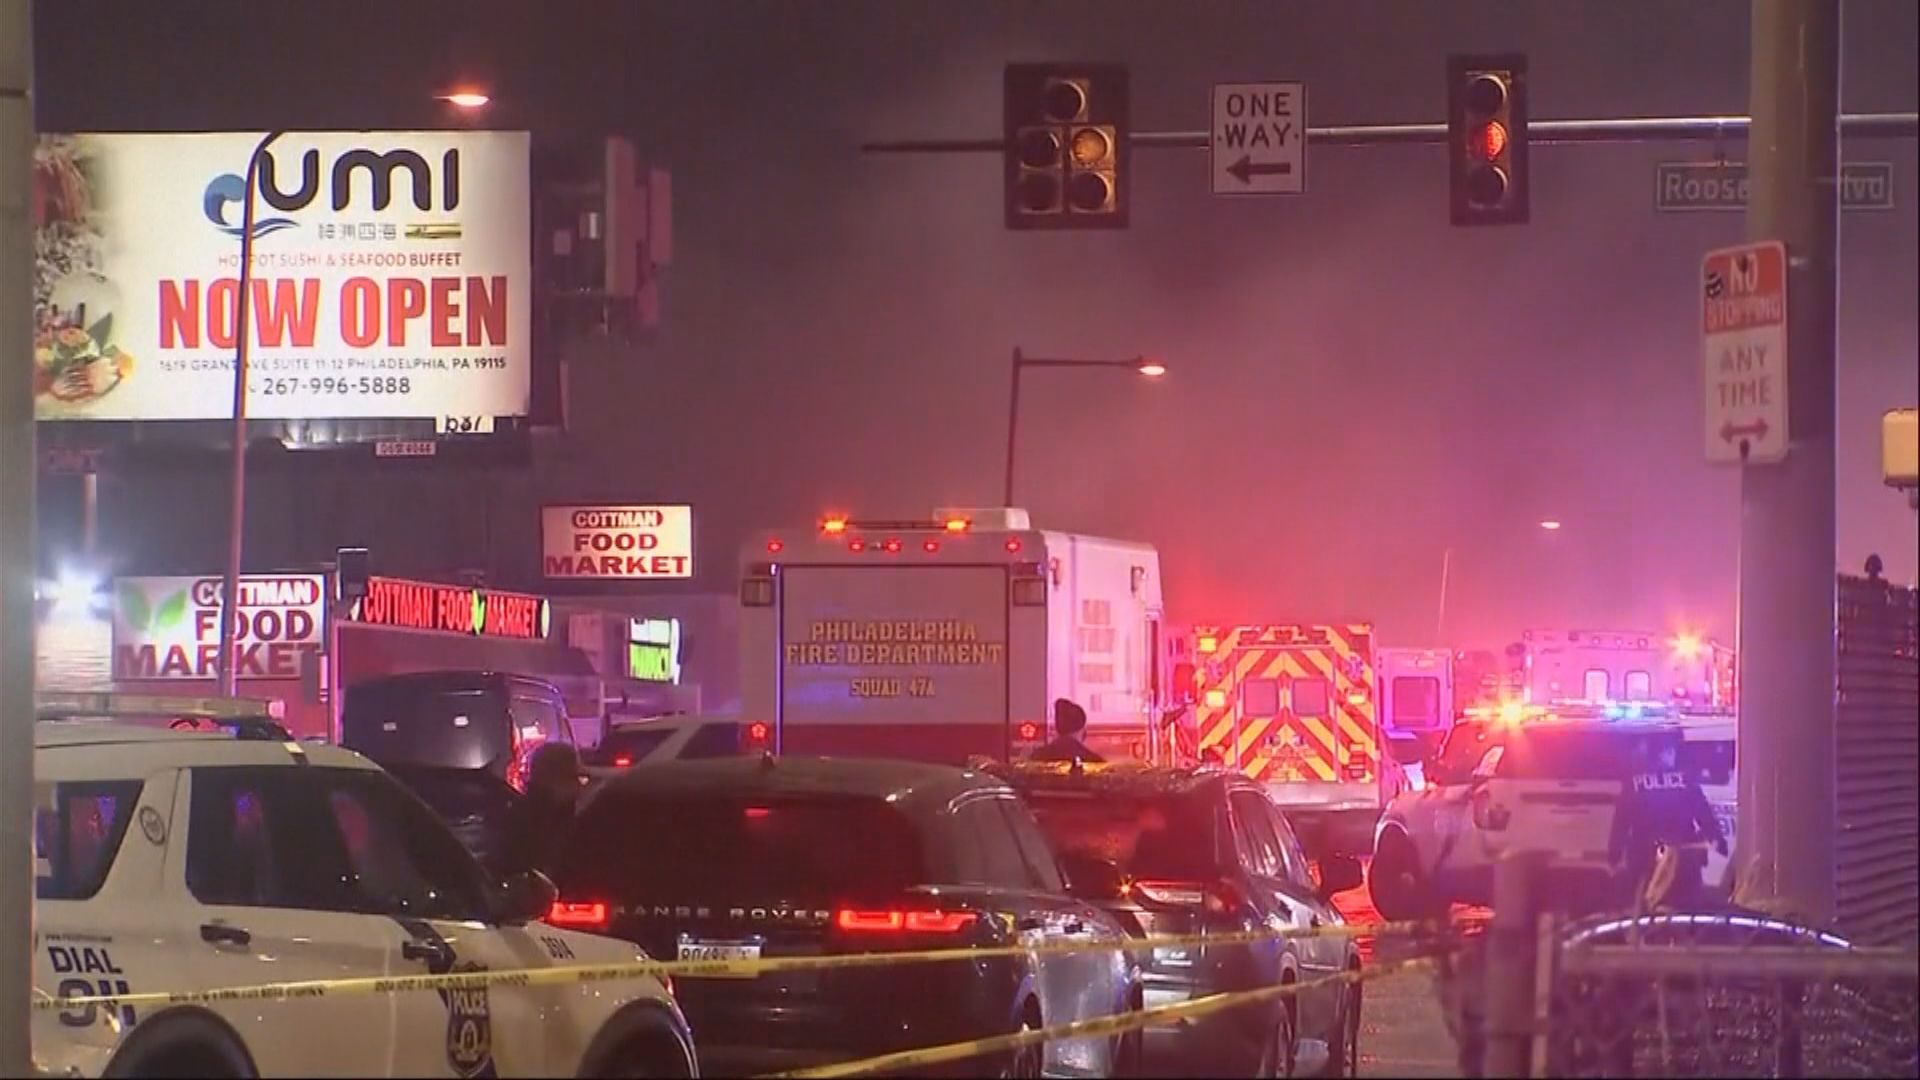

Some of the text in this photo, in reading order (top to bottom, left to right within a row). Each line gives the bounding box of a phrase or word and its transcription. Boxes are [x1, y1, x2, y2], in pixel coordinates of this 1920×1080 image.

[1227, 92, 1291, 118] ONE
[1225, 123, 1291, 148] WAY
[1843, 175, 1884, 199] lvd
[280, 254, 320, 267] SUSHI
[326, 254, 335, 266] &
[340, 253, 406, 267] SEAFOOD
[409, 252, 462, 267] BUFFET
[1729, 252, 1759, 296] NO
[159, 276, 508, 349] NOW OPEN
[273, 358, 310, 369] SUITE
[452, 357, 470, 369] PA
[474, 357, 507, 369] 19115
[1719, 346, 1768, 374] ANY
[263, 377, 411, 395] 267-996-5888
[1717, 377, 1771, 408] TIME
[575, 511, 657, 527] COTTMAN
[574, 533, 658, 551] FOOD
[546, 555, 688, 575] MARKET
[364, 580, 537, 638] COTTMAN FOOD MARKET
[811, 621, 976, 642] PHILADELPHIA
[786, 643, 1001, 665] FIRE DEPARTMENT
[851, 677, 936, 696] SQUAD 47A
[1632, 772, 1686, 792] POLICE
[729, 907, 830, 919] ROVER
[48, 946, 123, 974] DIAL
